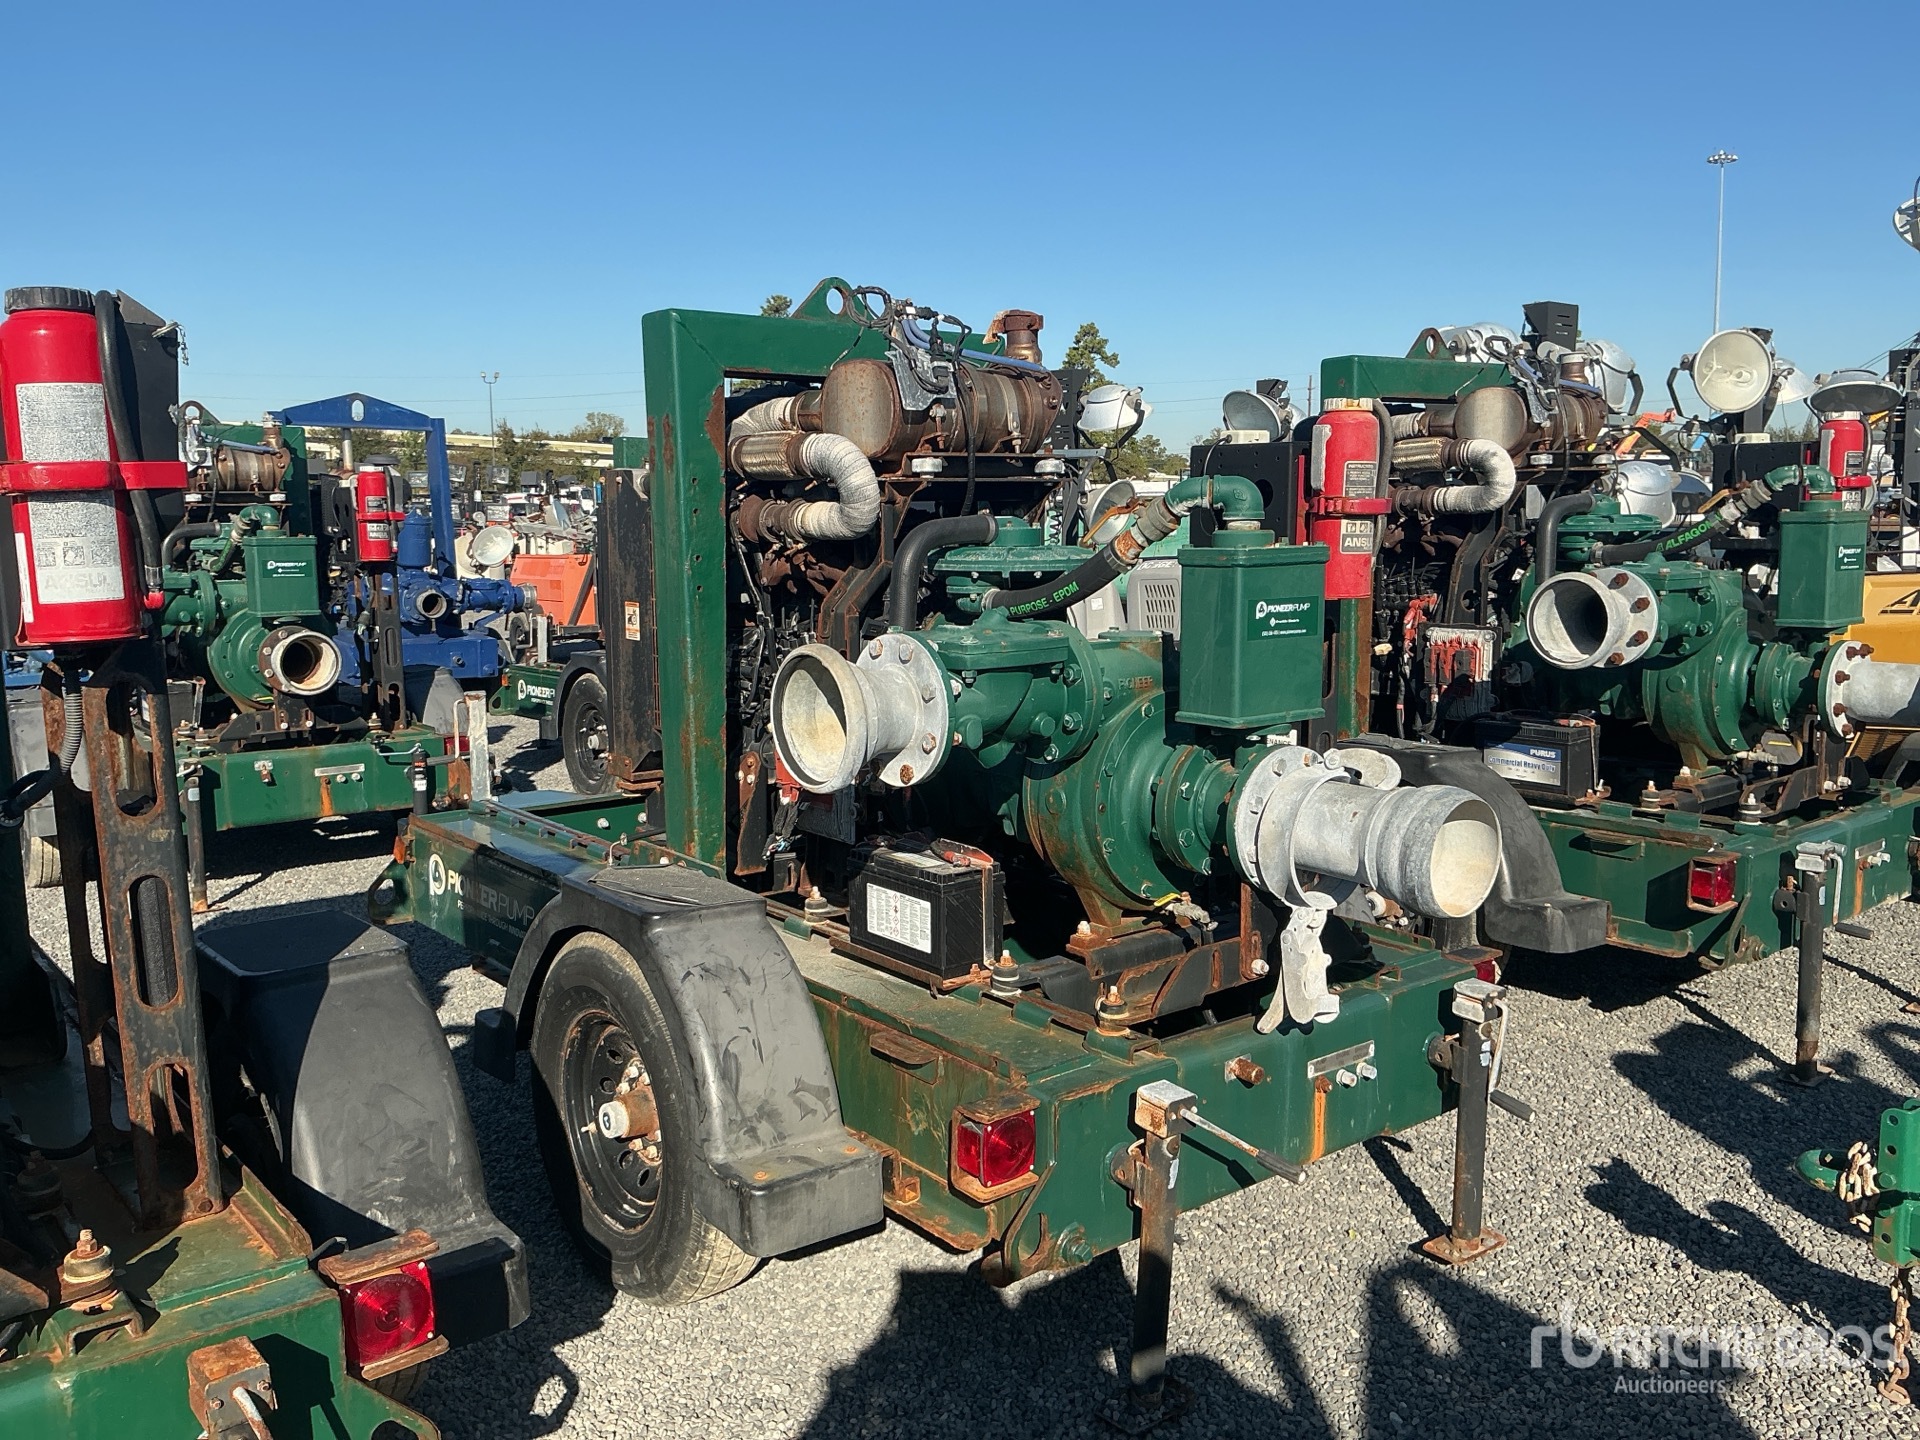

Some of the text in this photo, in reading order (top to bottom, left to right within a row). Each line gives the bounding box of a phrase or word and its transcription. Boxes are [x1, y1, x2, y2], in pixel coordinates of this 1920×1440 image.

[1344, 537, 1374, 547] ANSU
[1009, 597, 1050, 616] PURPOSE
[1052, 581, 1080, 604] EPDM
[1266, 602, 1311, 613] PIONEERPUMP
[1529, 748, 1557, 759] PURUS
[1488, 755, 1523, 768] Commercial
[1523, 760, 1541, 770] Heavy
